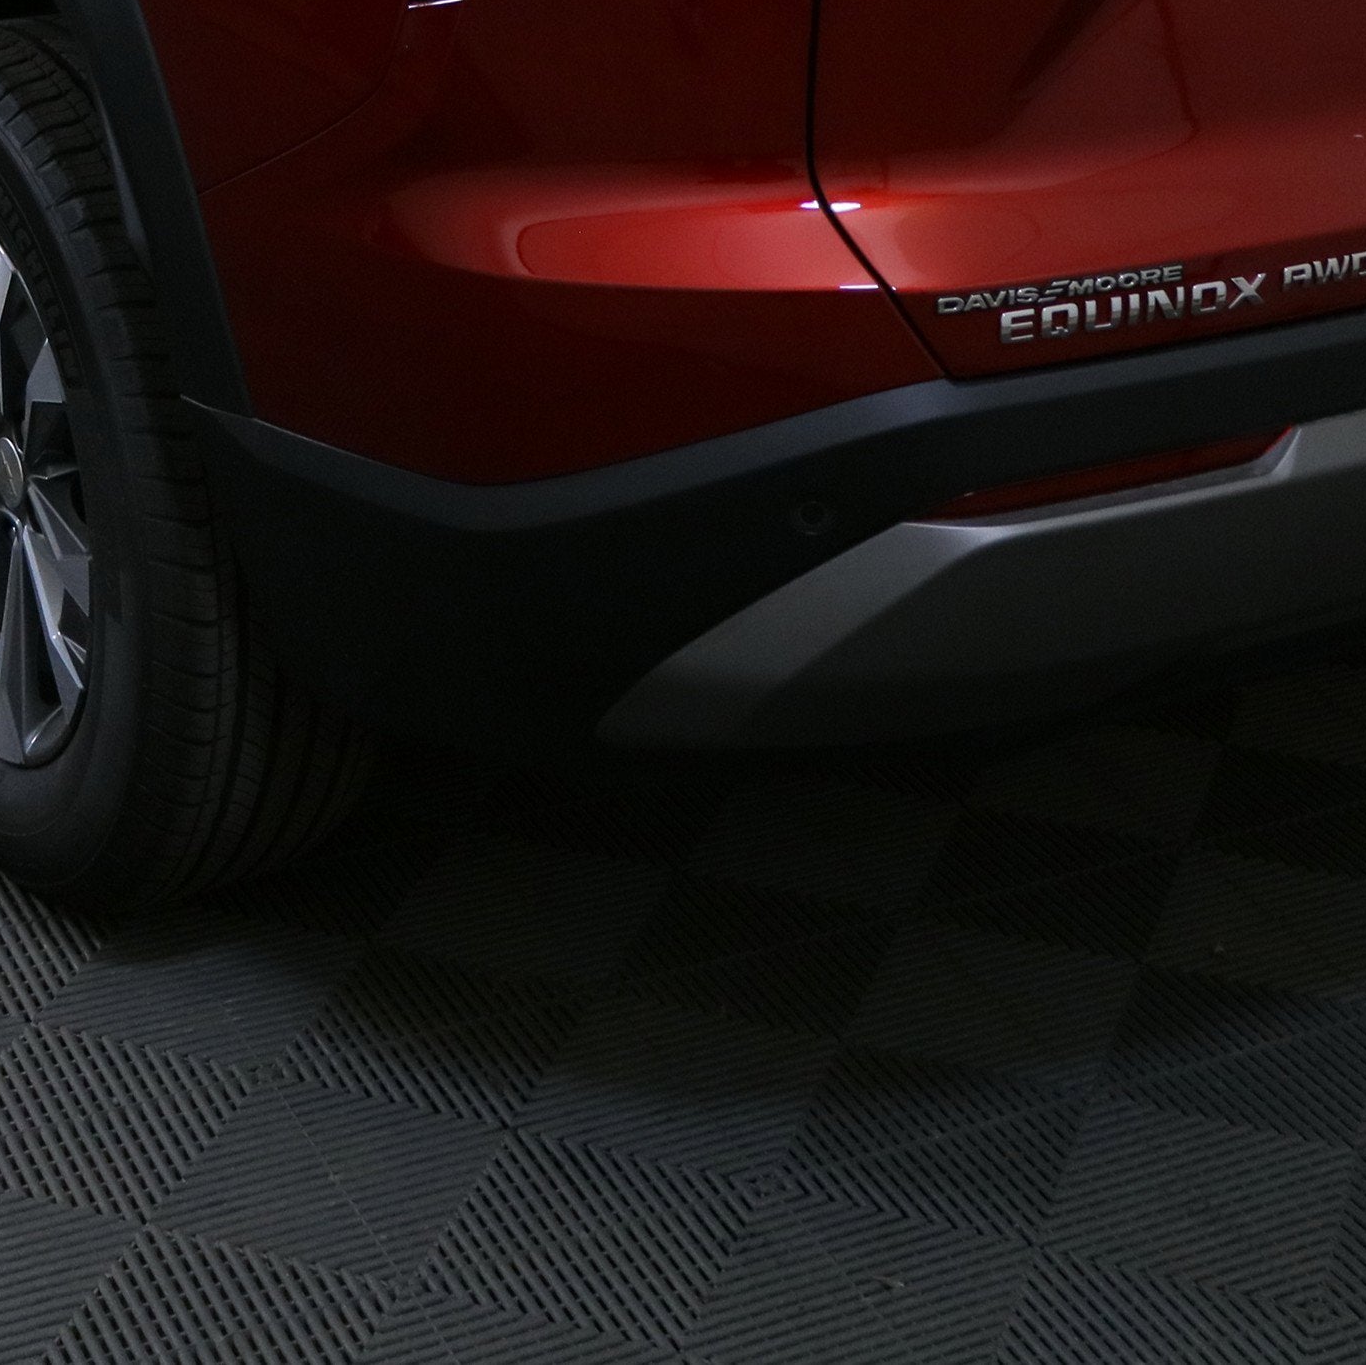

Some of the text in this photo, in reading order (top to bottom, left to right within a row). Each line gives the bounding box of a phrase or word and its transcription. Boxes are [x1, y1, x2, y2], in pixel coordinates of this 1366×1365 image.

[937, 265, 1183, 315] DAVIS MOORE
[999, 272, 1267, 345] EQUINOX
